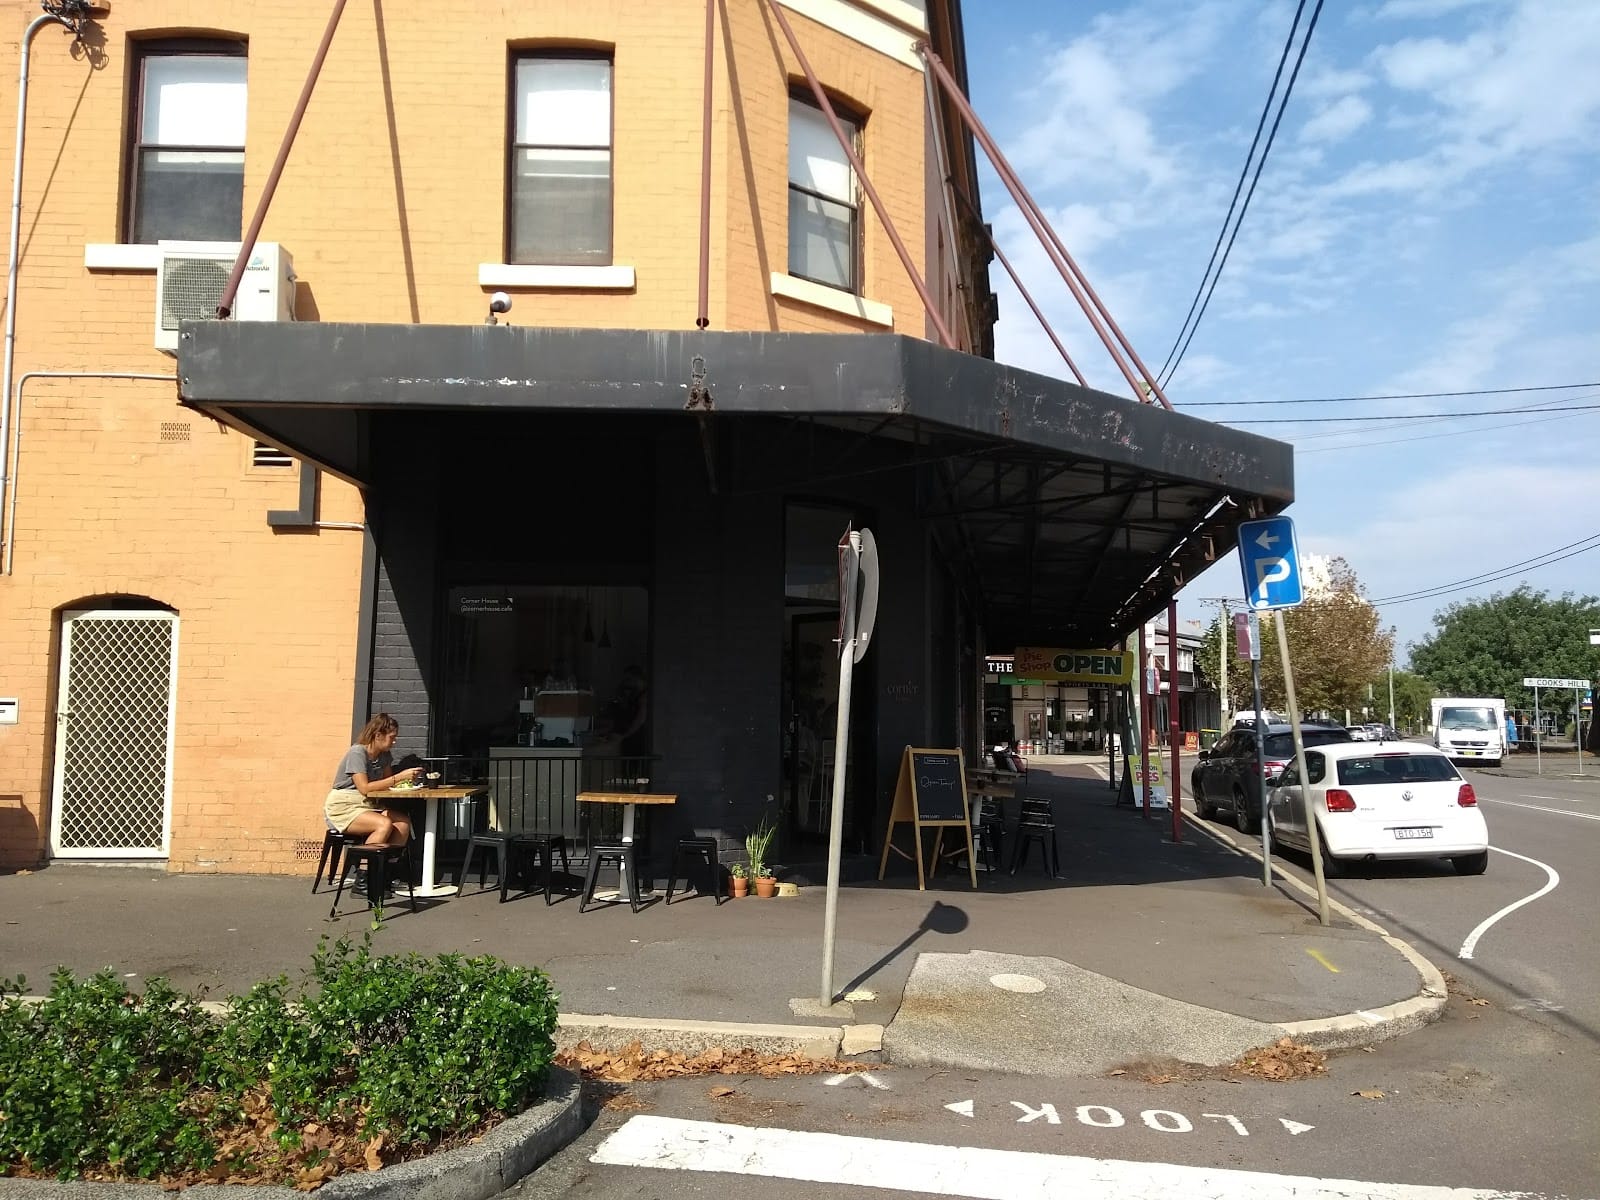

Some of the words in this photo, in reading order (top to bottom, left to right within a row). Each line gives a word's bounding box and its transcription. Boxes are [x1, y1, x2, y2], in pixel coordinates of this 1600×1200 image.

[987, 662, 1014, 673] THE
[1053, 654, 1122, 676] OPEN
[1537, 679, 1564, 687] COOKS
[1567, 680, 1587, 688] HILL
[1135, 771, 1160, 782] PES
[1010, 1100, 1250, 1136] LOOK
